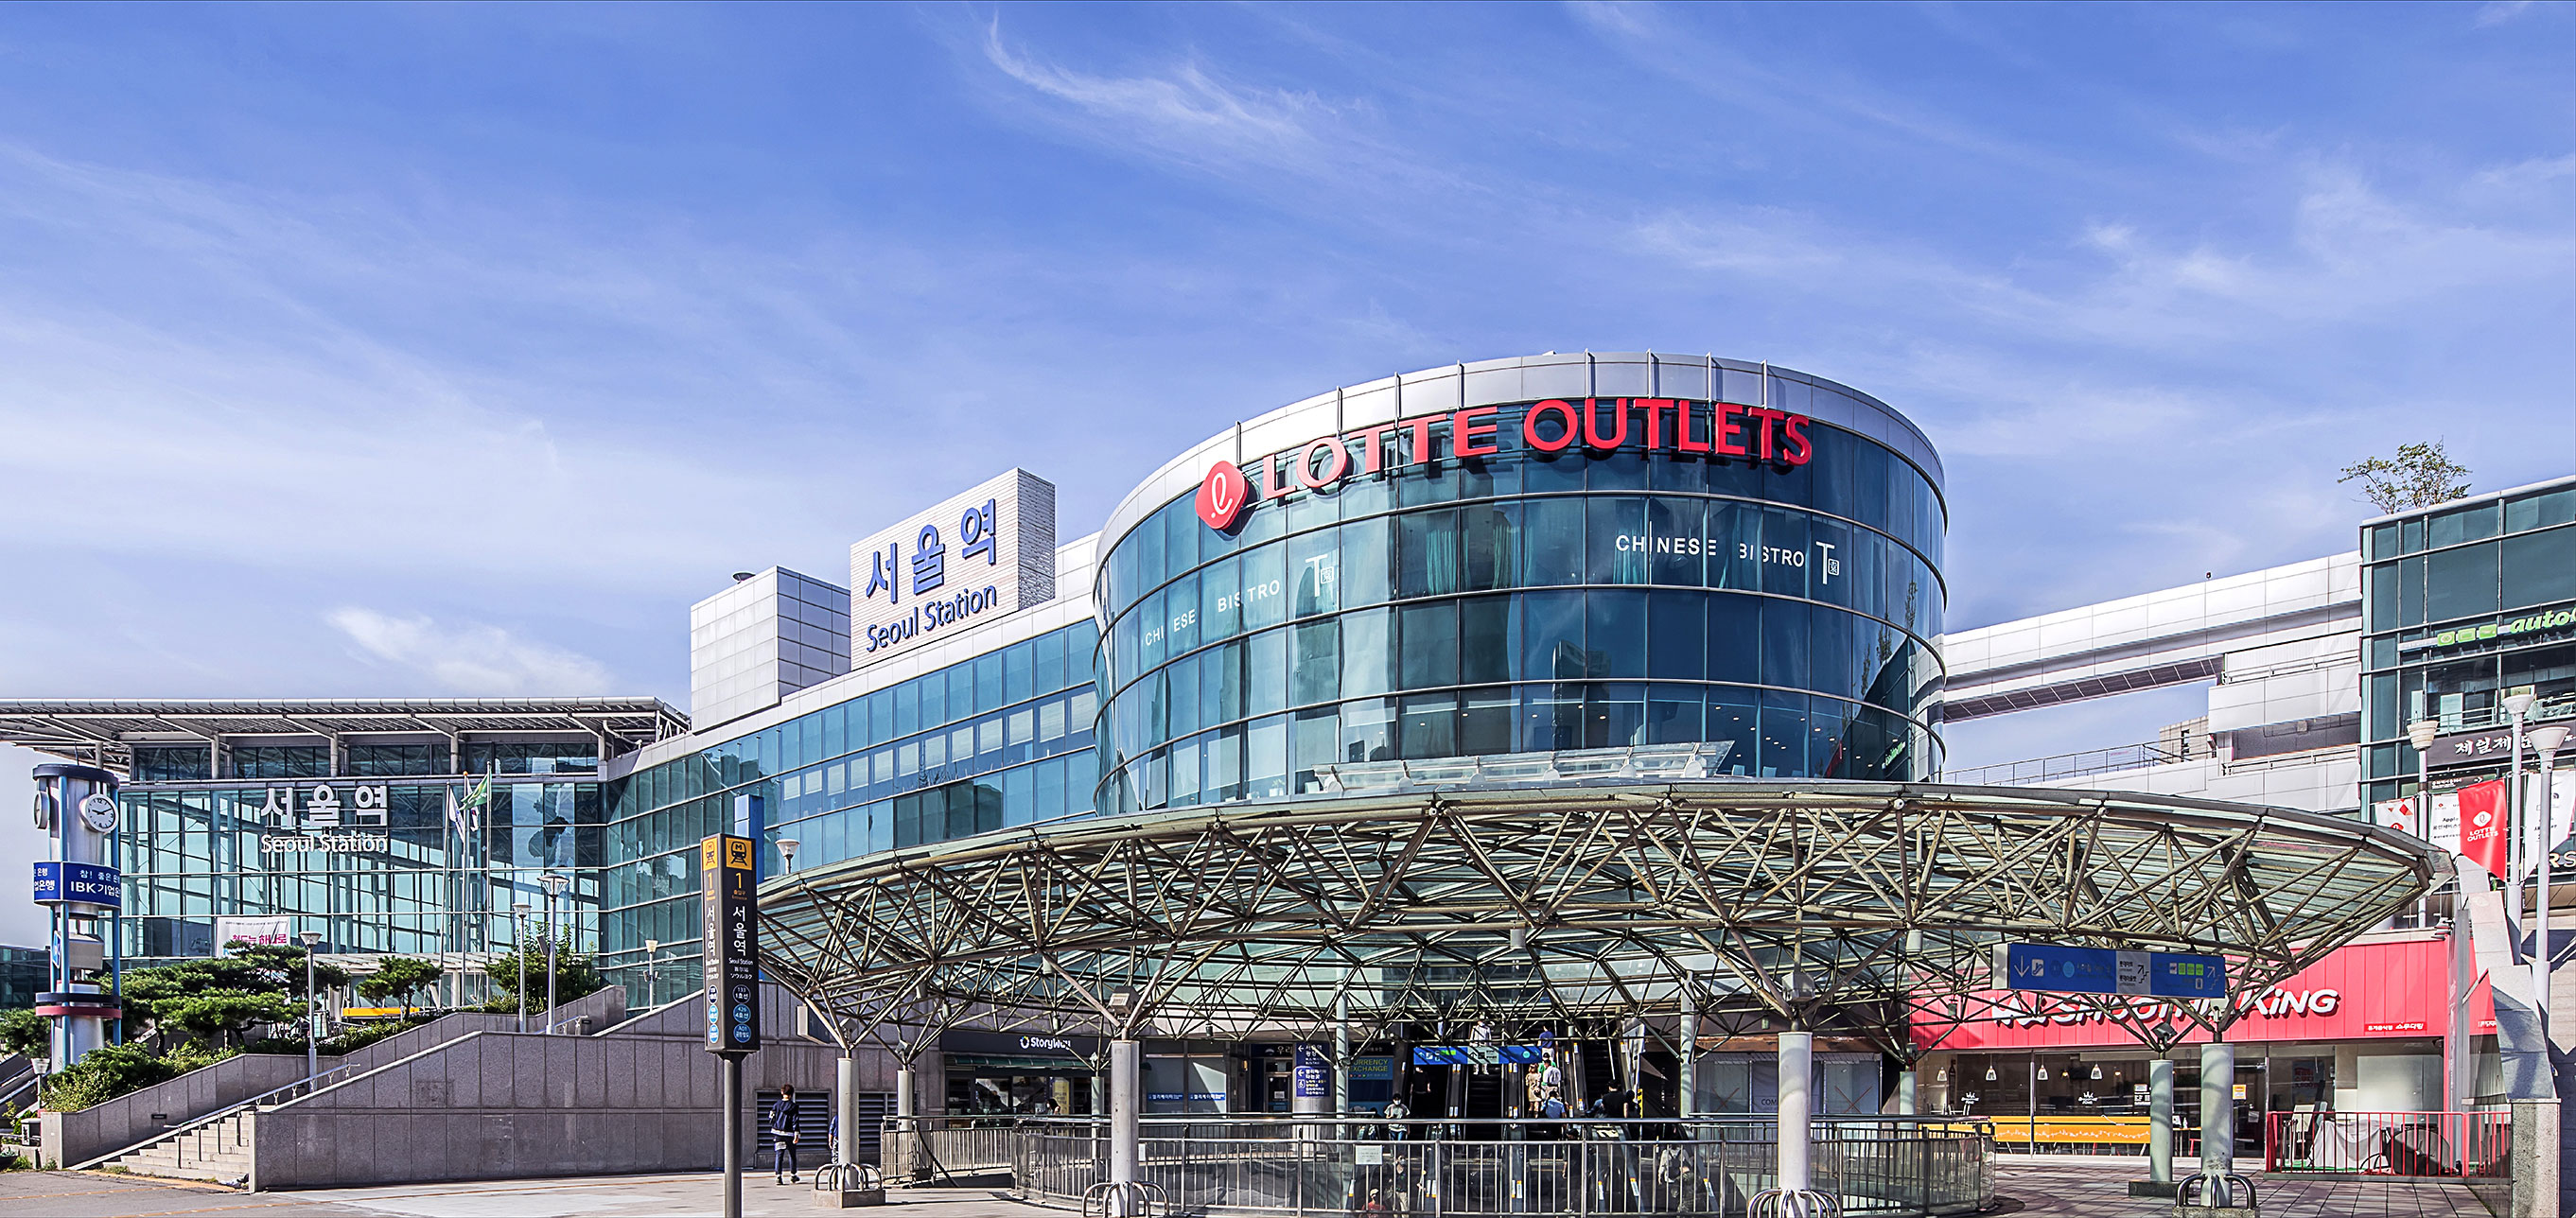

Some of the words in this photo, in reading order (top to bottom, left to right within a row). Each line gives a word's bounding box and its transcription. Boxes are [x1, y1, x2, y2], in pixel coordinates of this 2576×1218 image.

[1262, 406, 1498, 500] LOTTE
[1523, 397, 1813, 467] OUTLETS
[866, 498, 997, 603] 서울역
[1615, 534, 1717, 556] CHINESE
[1739, 542, 1805, 567] BISTRO
[866, 604, 920, 652] Seoul
[923, 583, 998, 633] Station
[1145, 608, 1197, 647] CHIESE
[1218, 579, 1281, 613] BISTRO
[260, 784, 388, 827] 서울역
[260, 833, 315, 854] Seoul
[318, 833, 389, 853] Station
[2466, 830, 2499, 843] OUTLETS
[2468, 825, 2496, 837] LOTTE
[2549, 850, 2576, 868] RS
[708, 872, 713, 889] 1
[735, 872, 742, 889] 1
[707, 905, 716, 956] 서울역
[732, 906, 747, 956] 서울역
